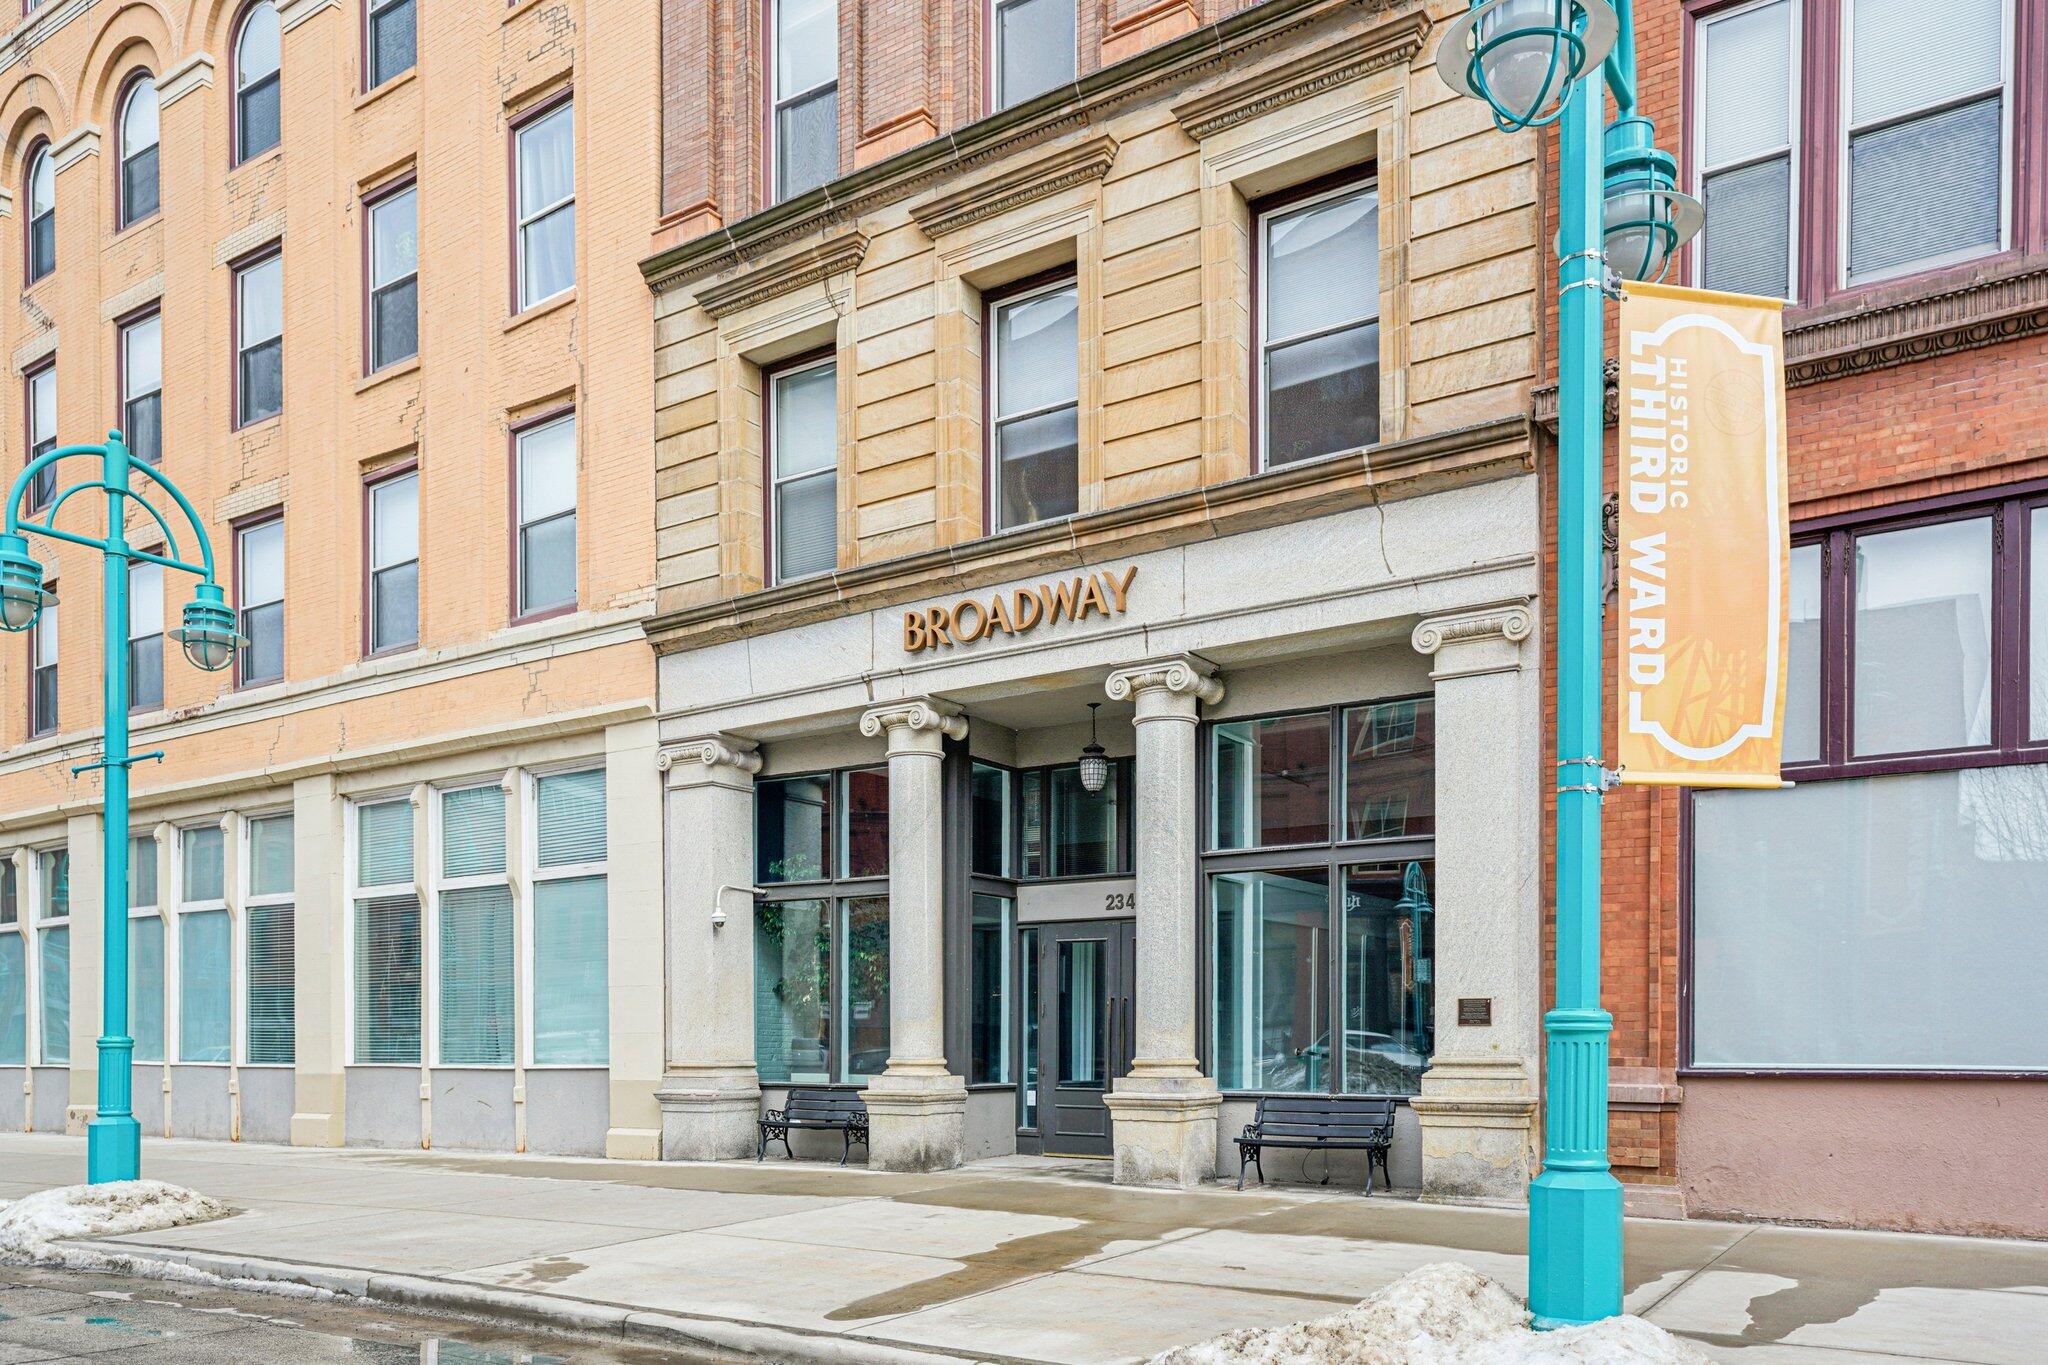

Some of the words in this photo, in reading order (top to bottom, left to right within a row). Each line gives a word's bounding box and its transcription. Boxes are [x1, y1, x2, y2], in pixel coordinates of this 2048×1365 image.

[1630, 355, 1666, 513] THIRD
[1670, 357, 1688, 508] HISTORIC
[904, 565, 1138, 652] BROADWAY
[1629, 532, 1665, 684] WARD
[1105, 893, 1135, 911] 234
